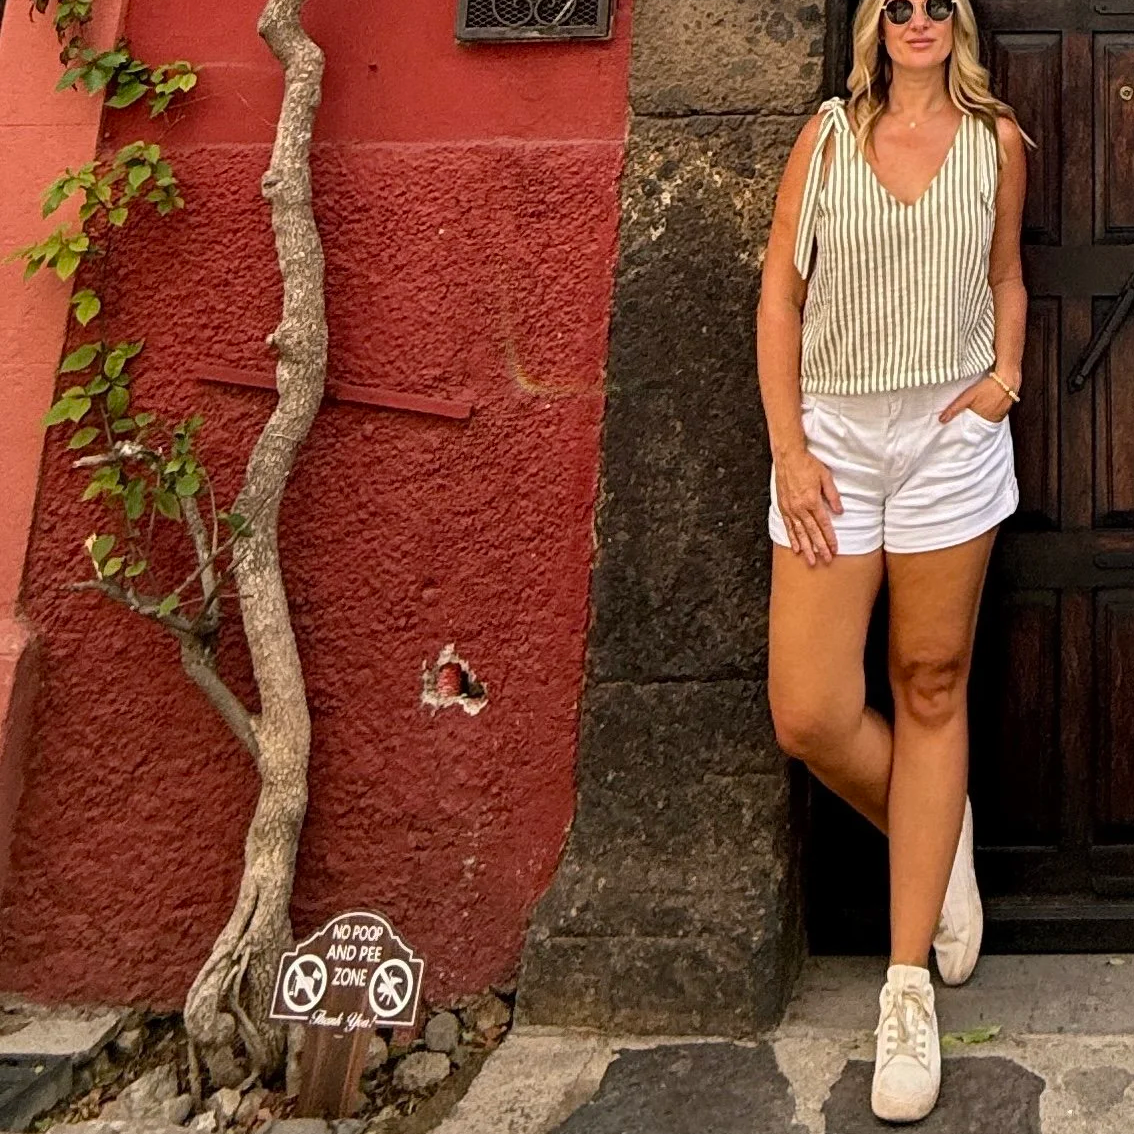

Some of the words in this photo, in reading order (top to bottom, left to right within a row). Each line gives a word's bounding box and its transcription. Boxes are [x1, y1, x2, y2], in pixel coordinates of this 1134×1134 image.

[332, 924, 351, 940] NO
[352, 925, 384, 942] POOP
[326, 944, 357, 961] AND
[358, 946, 383, 963] PEE
[331, 967, 368, 987] ZONE
[309, 1010, 343, 1026] Thank
